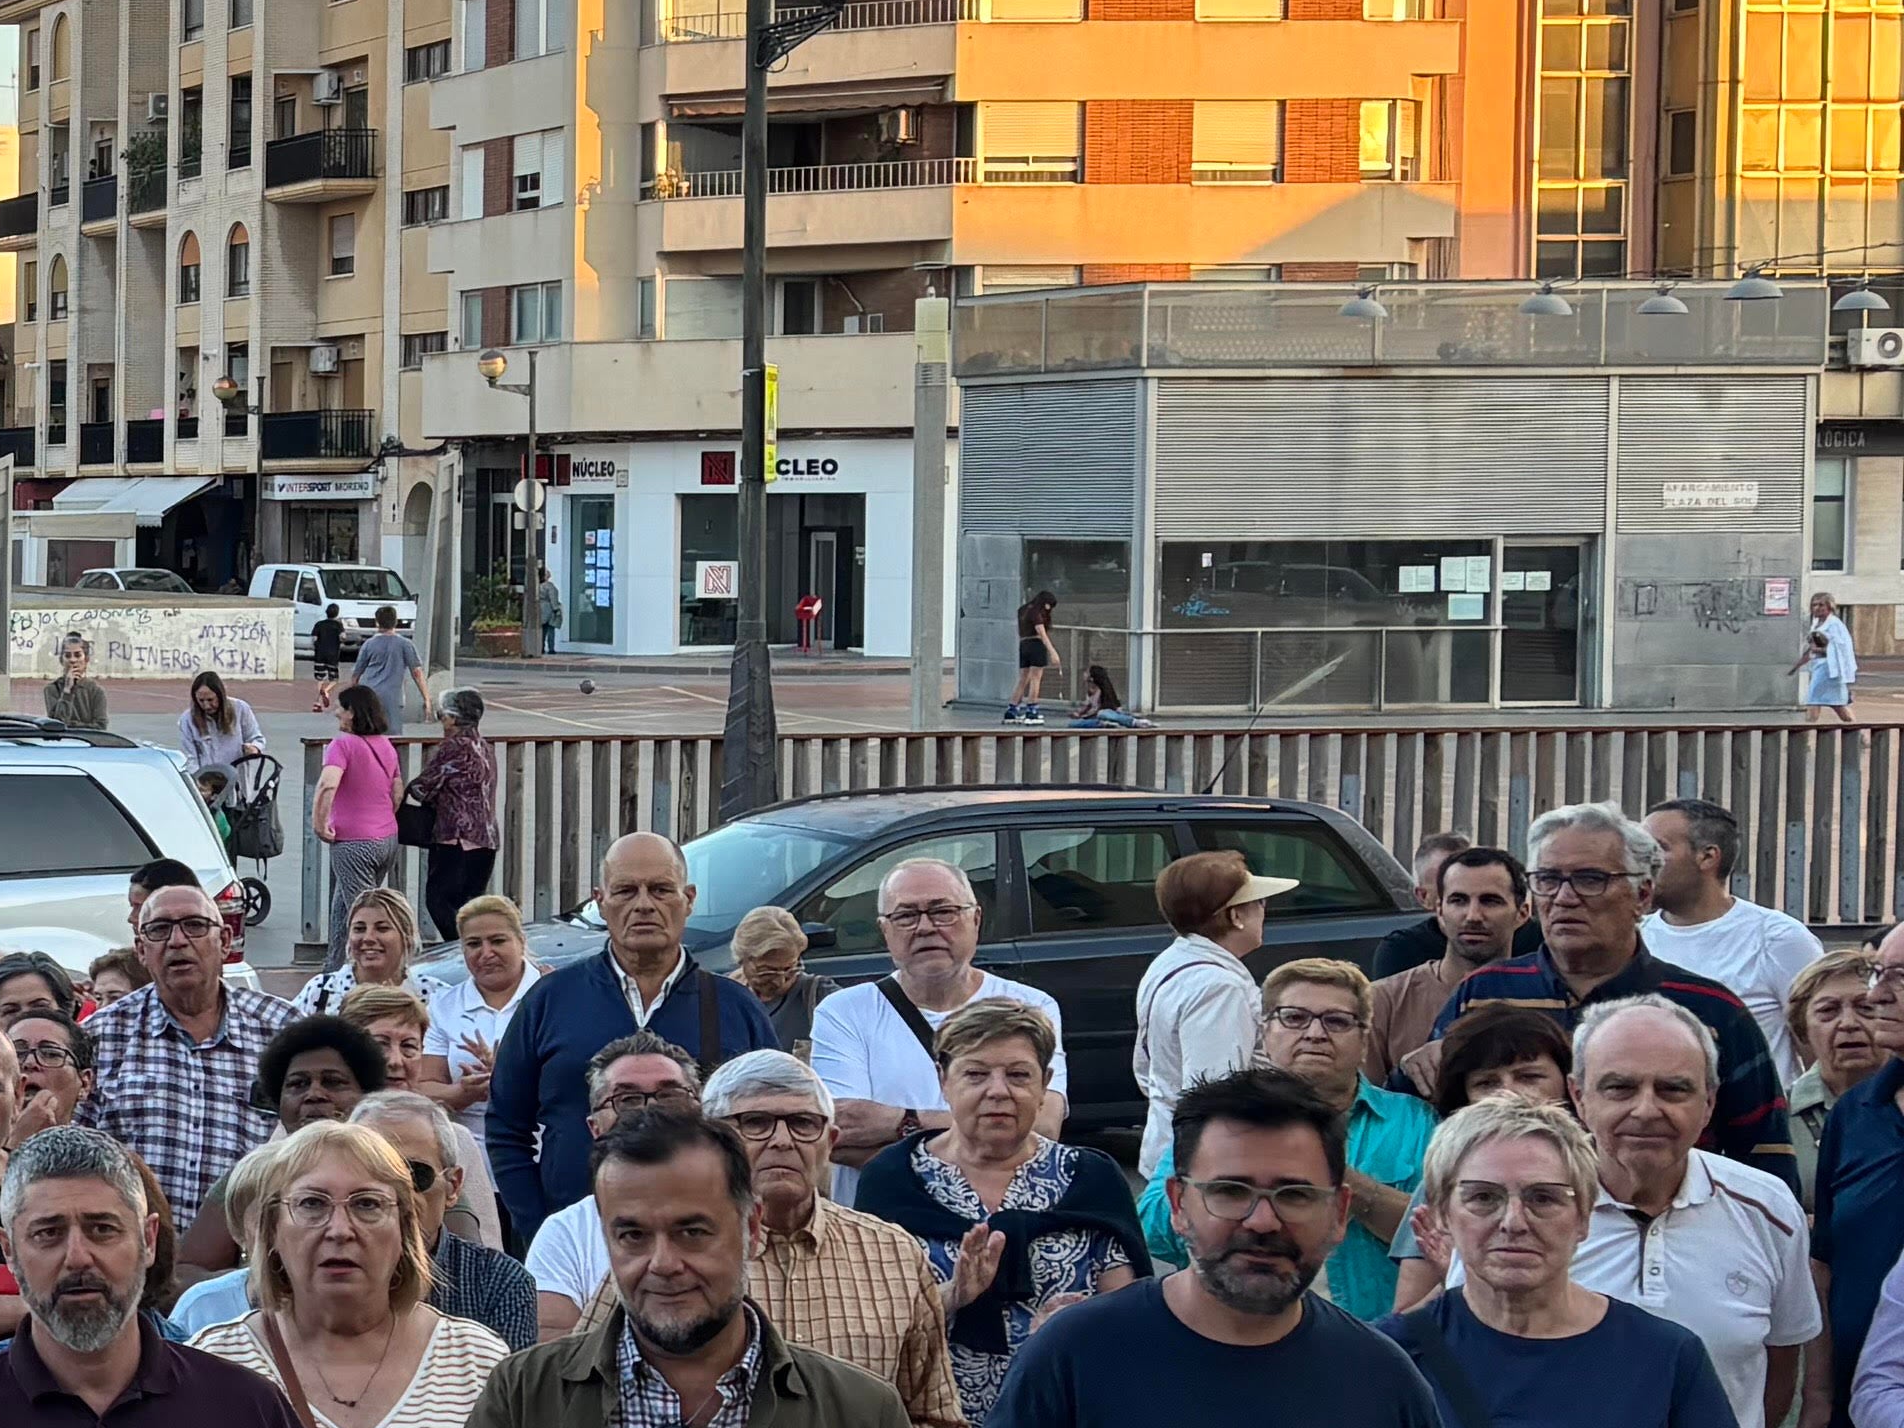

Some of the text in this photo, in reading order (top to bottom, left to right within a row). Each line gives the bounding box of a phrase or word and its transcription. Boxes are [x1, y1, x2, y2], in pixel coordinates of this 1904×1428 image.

[573, 457, 615, 478] NÚCLEO
[775, 458, 839, 476] CLEO
[212, 646, 267, 674] KIKE
